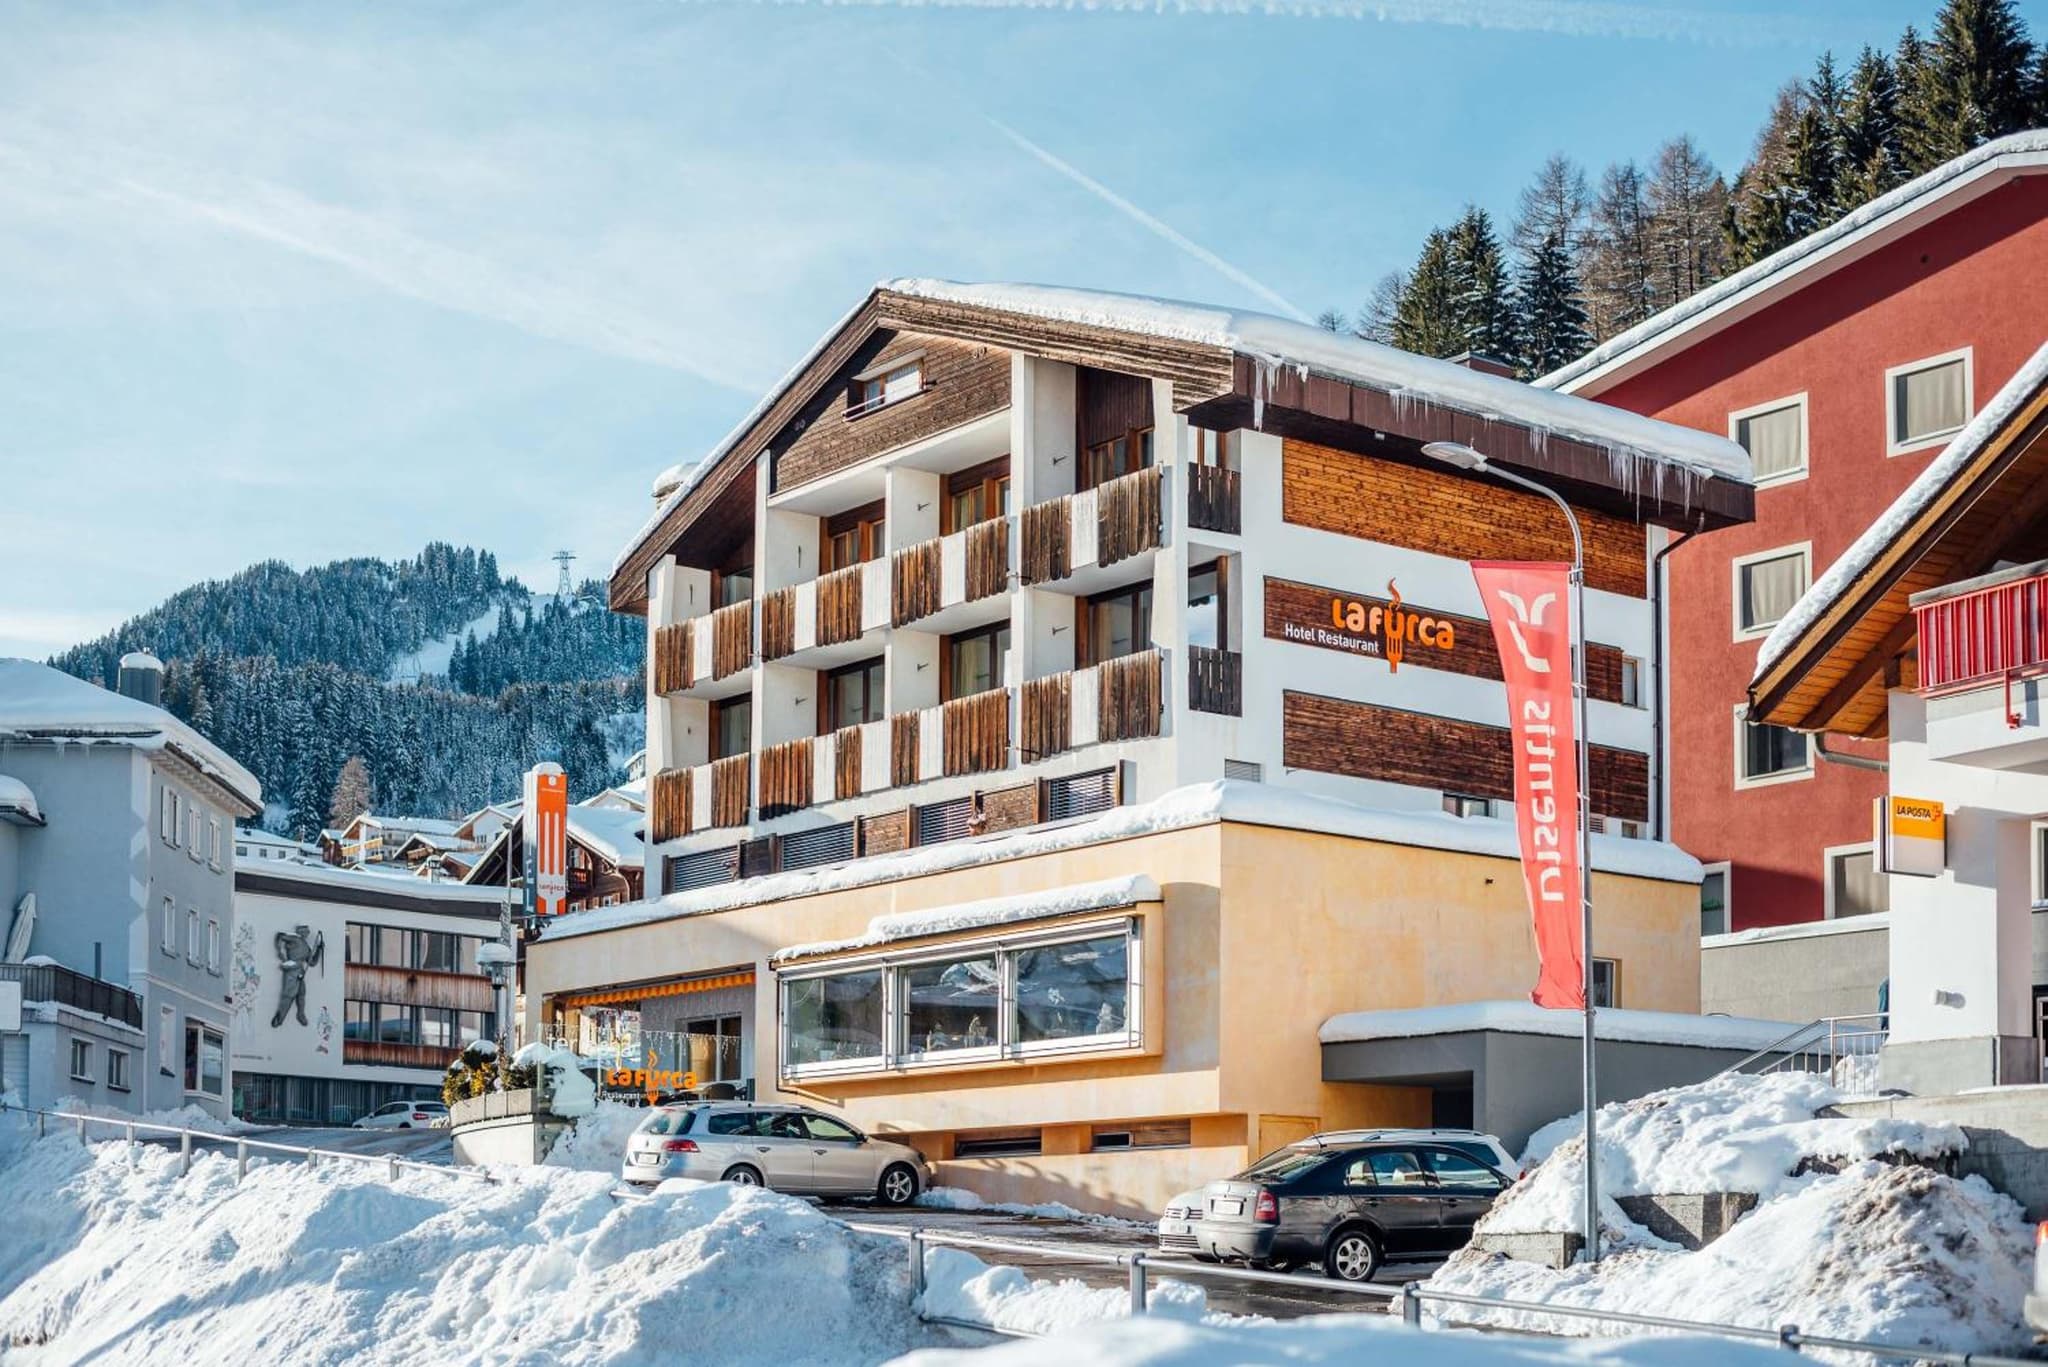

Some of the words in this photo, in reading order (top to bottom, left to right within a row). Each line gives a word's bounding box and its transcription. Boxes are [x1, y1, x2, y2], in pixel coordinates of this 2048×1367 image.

[1285, 623, 1316, 641] Hotel
[1318, 629, 1379, 654] Restaurant
[1896, 805, 1906, 815] LA
[1906, 807, 1931, 818] POSTA
